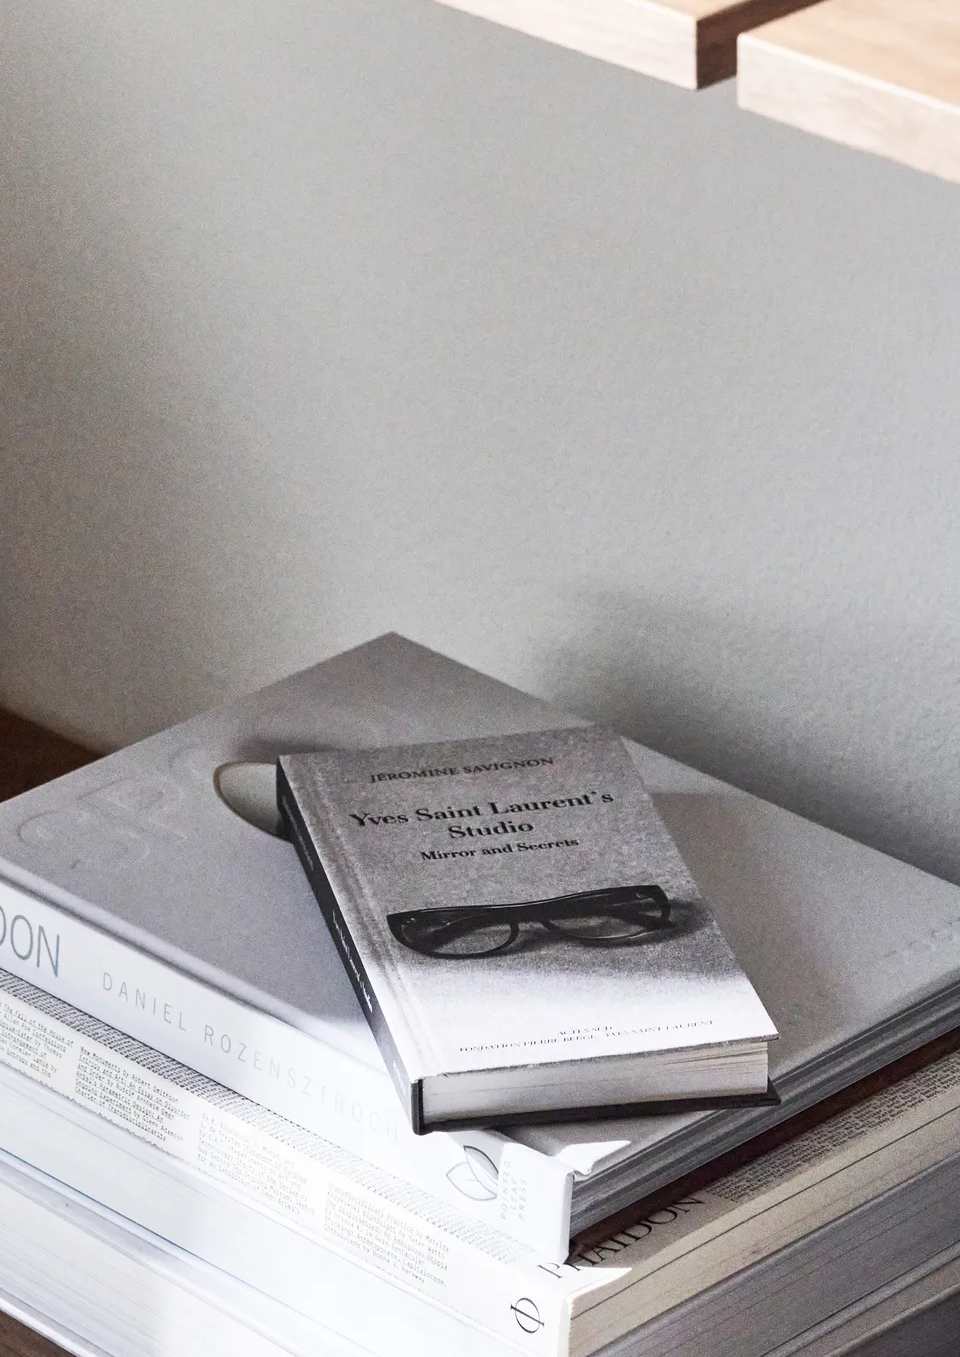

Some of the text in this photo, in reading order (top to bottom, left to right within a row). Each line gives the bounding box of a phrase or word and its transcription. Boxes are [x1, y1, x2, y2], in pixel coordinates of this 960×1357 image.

[462, 755, 555, 775] SAVIGNON
[349, 791, 614, 828] Yves Saint Laurent's
[447, 820, 535, 840] Studio
[420, 837, 580, 862] Mirror and Secrets
[102, 971, 187, 1032] DANIEL
[204, 1024, 399, 1142] ROZENSZTROCH
[459, 1041, 521, 1052] FONDATION
[538, 1195, 706, 1279] PHAIDON
